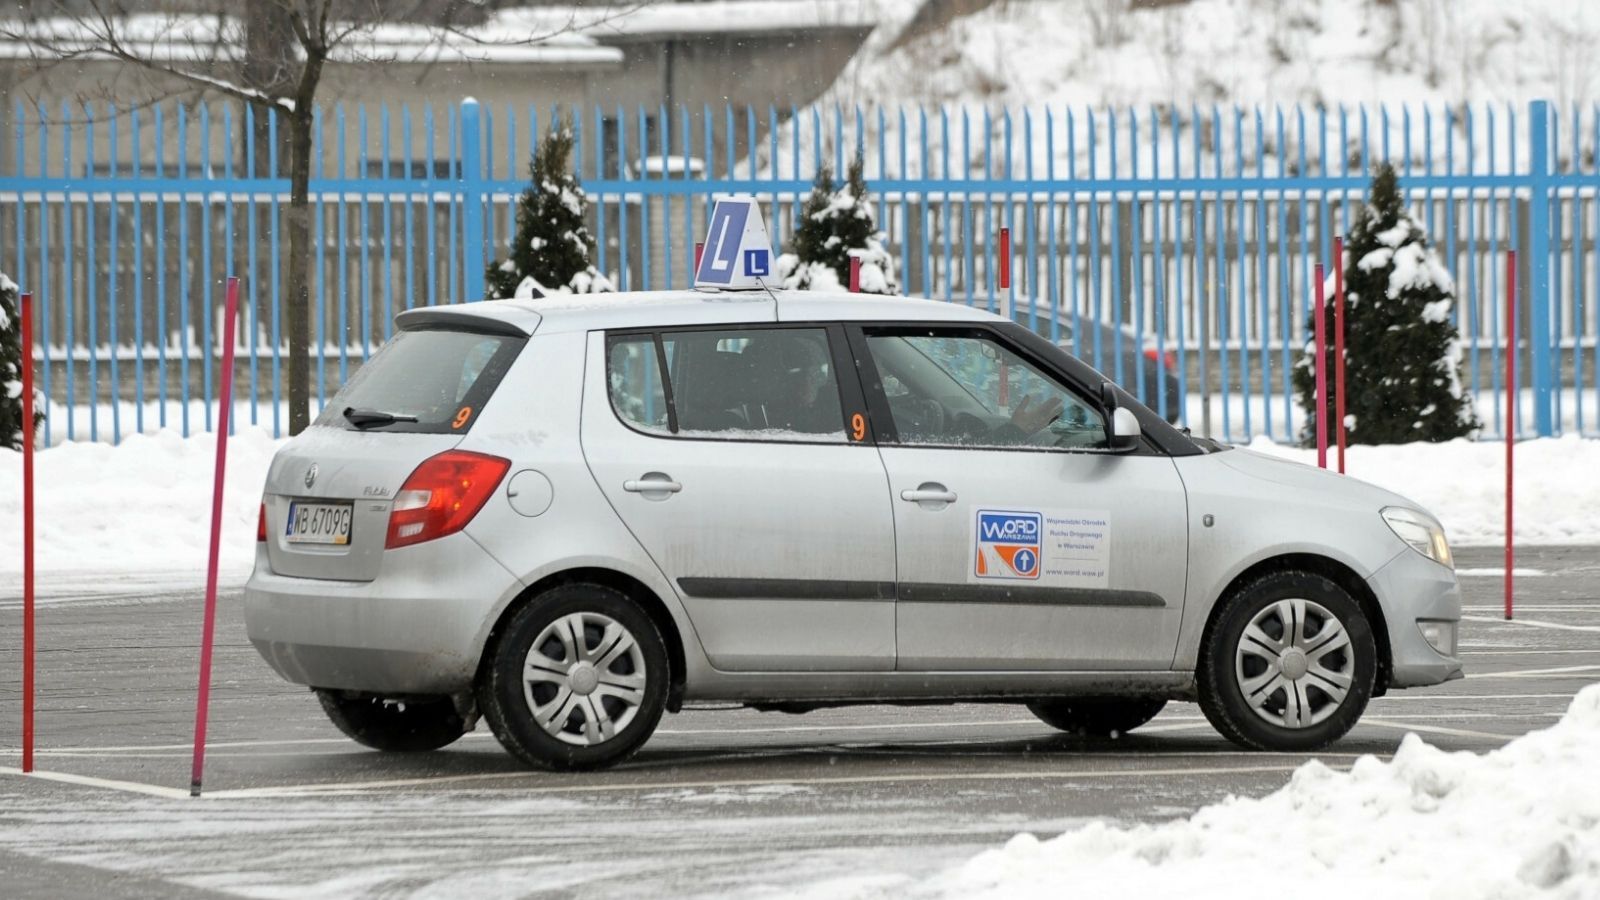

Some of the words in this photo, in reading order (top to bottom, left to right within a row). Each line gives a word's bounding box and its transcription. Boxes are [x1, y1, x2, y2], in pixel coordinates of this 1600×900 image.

[711, 215, 730, 270] L
[751, 253, 764, 273] L
[452, 407, 472, 429] 9
[852, 413, 865, 441] 9
[294, 507, 309, 534] WB
[311, 508, 349, 535] 6709G
[982, 519, 1037, 539] WORD
